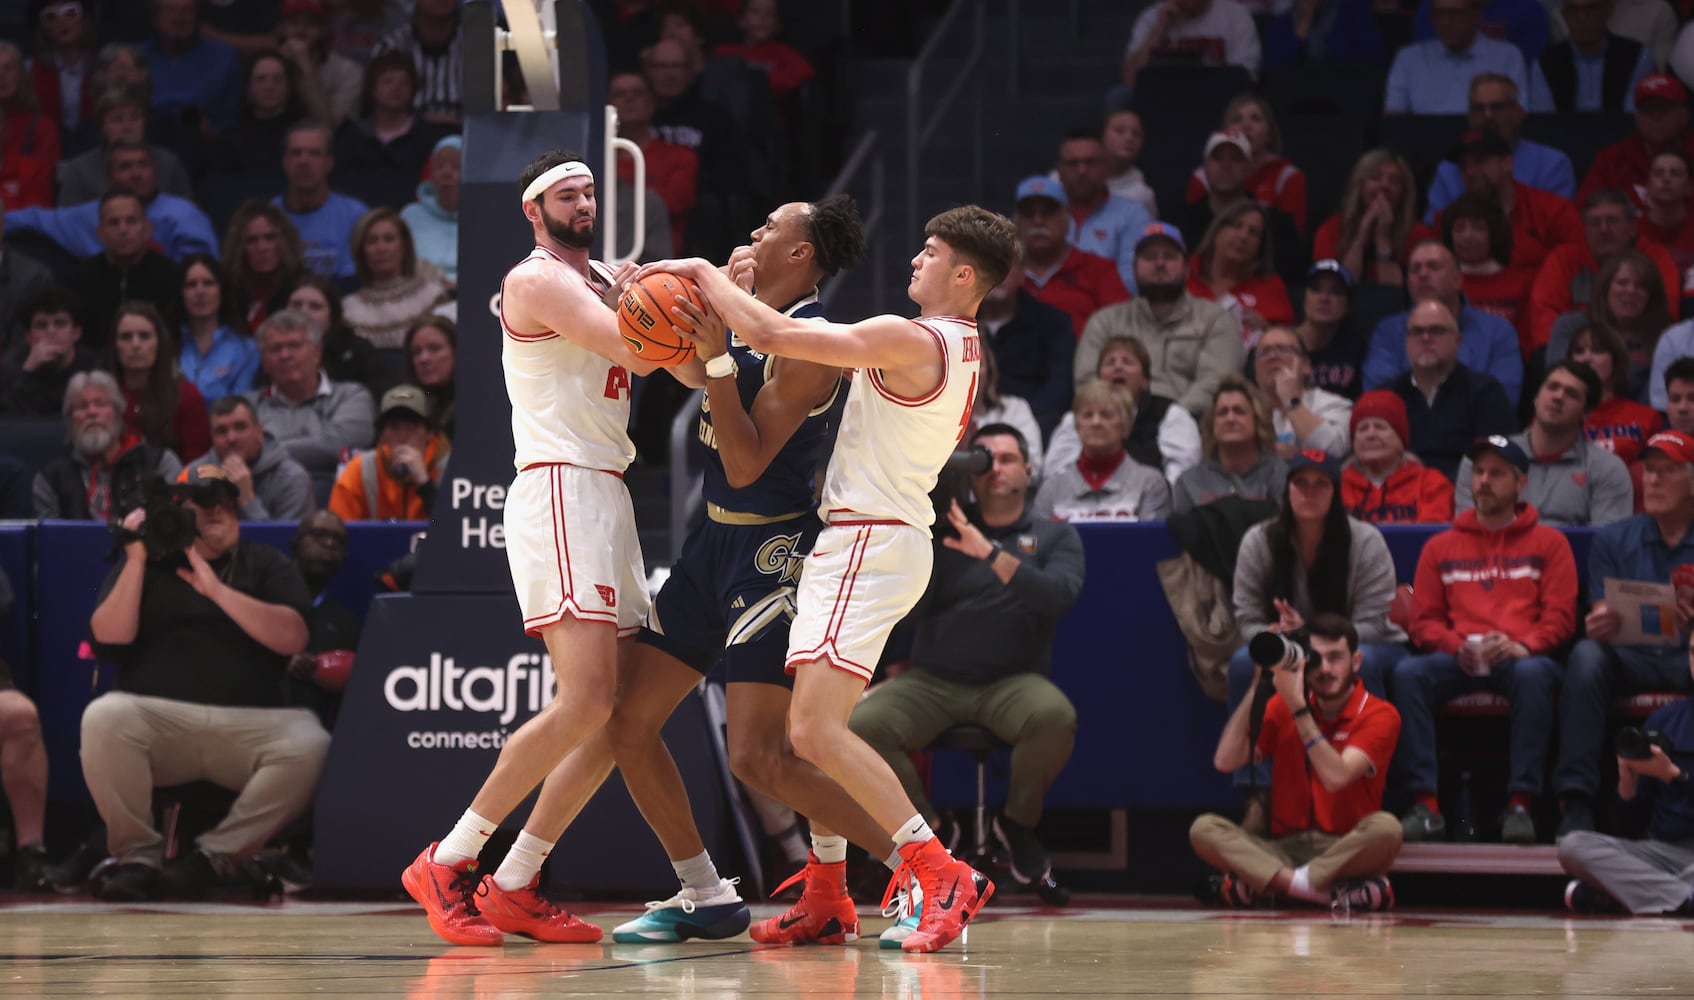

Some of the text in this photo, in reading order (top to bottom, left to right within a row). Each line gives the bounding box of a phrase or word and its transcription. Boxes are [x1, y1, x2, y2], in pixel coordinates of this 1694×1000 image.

[623, 292, 656, 332] ELITE
[452, 477, 509, 511] Pre
[407, 728, 510, 750] connecti
